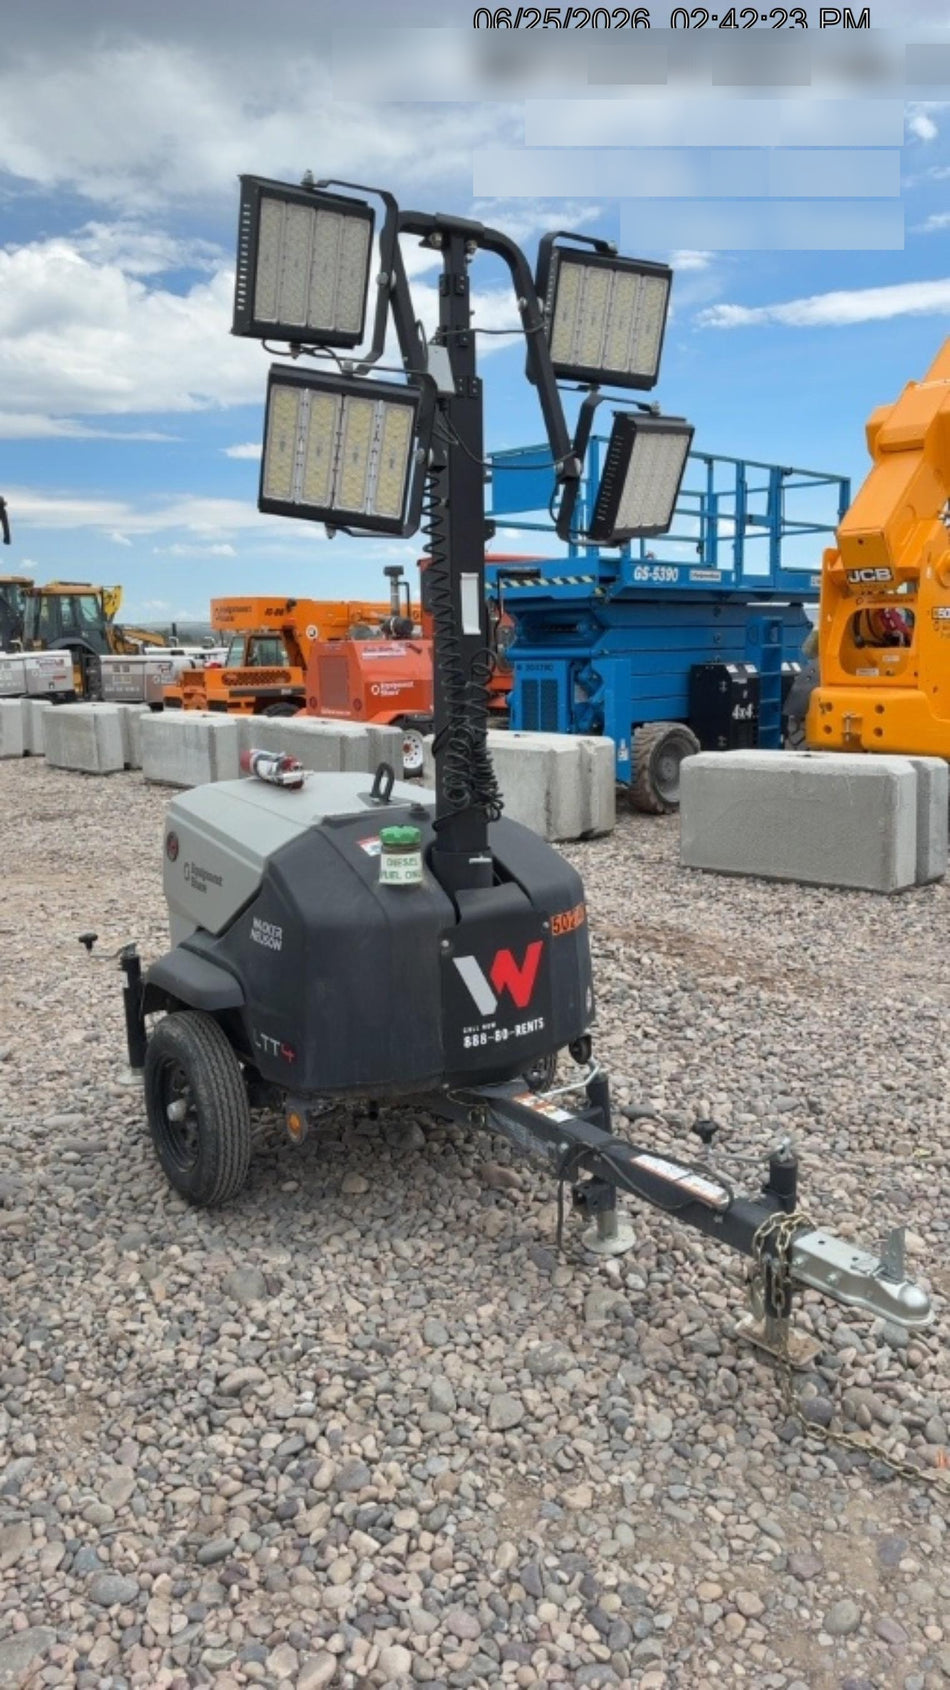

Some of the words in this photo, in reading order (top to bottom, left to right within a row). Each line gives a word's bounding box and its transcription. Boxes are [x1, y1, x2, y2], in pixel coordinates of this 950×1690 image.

[634, 565, 679, 582] GS-5390
[848, 568, 892, 583] JCB
[732, 703, 754, 720] 4x4
[386, 857, 418, 867] DIESEL
[252, 917, 282, 940] WACKER
[250, 928, 282, 951] NEUSON
[482, 1022, 496, 1031] NOW
